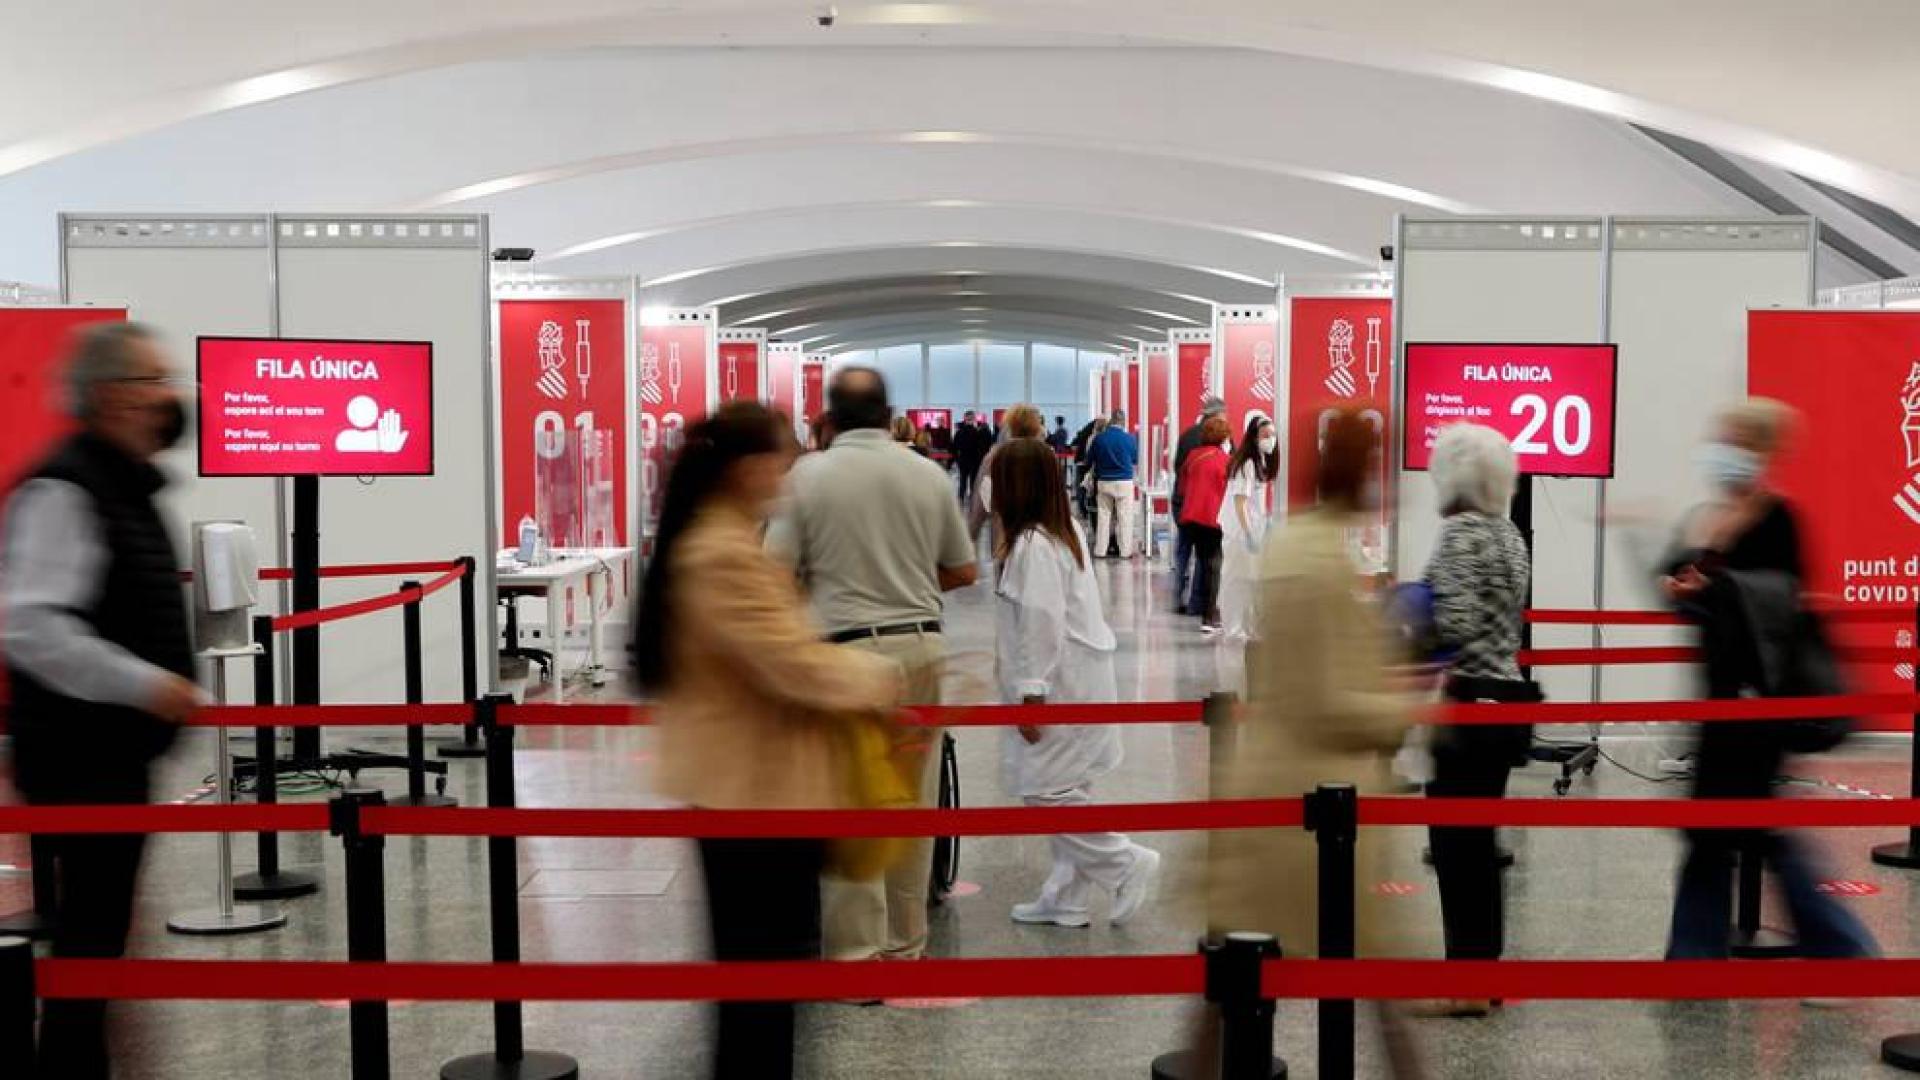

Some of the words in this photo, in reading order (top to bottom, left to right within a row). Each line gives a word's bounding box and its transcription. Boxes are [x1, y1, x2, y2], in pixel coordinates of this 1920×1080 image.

[256, 358, 304, 379] FILA
[310, 355, 378, 379] ÚNICA
[1463, 365, 1498, 381] FILA
[1502, 362, 1552, 382] ÚNICA
[224, 392, 241, 402] Por
[224, 428, 241, 438] Por
[535, 411, 594, 459] 01
[1510, 393, 1592, 457] 20
[1844, 556, 1897, 580] punt
